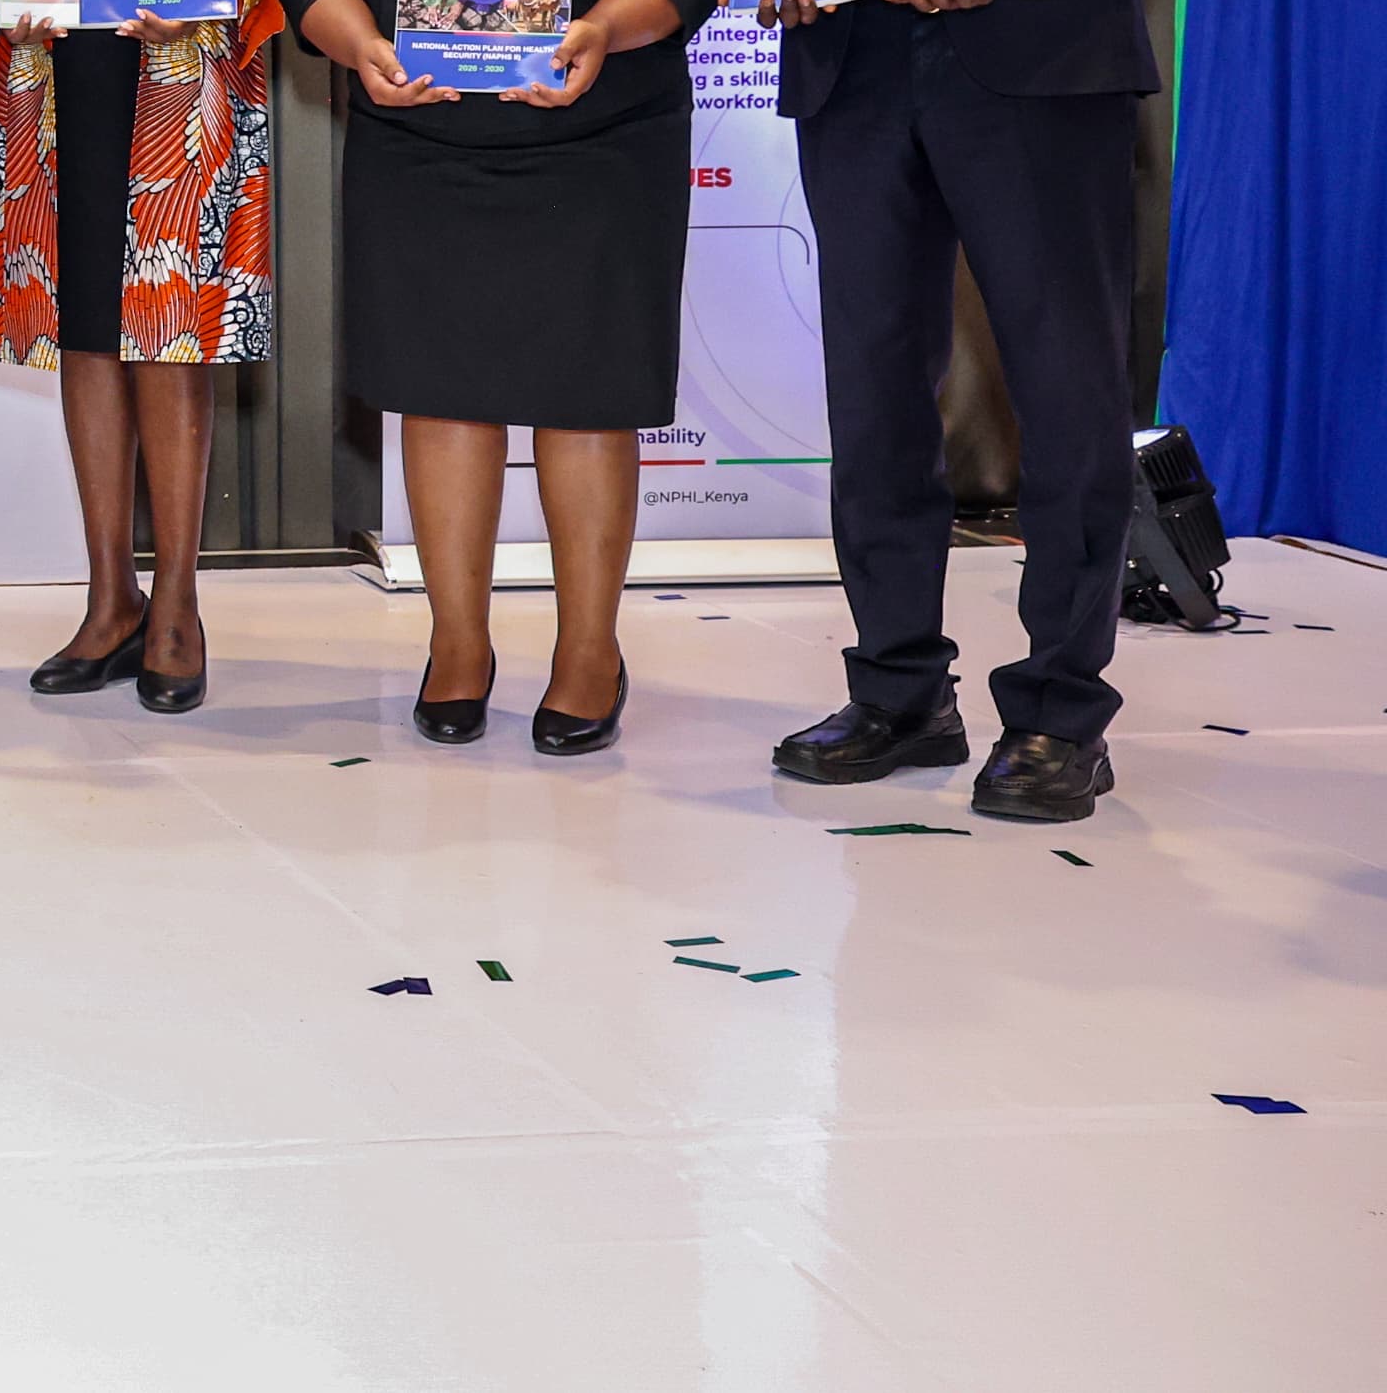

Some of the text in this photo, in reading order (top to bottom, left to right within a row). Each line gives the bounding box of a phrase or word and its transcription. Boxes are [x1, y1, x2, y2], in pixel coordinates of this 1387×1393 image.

[707, 26, 782, 44] integra
[411, 42, 555, 54] NATIONAL ACTION PLAN FOR HEALTH
[442, 51, 482, 60] SECURITY
[687, 49, 778, 64] dence-ba
[713, 75, 724, 86] a
[730, 70, 780, 86] skille
[695, 94, 780, 109] workfor
[637, 428, 706, 446] nability
[643, 490, 749, 506] @NPHI_Kenya
